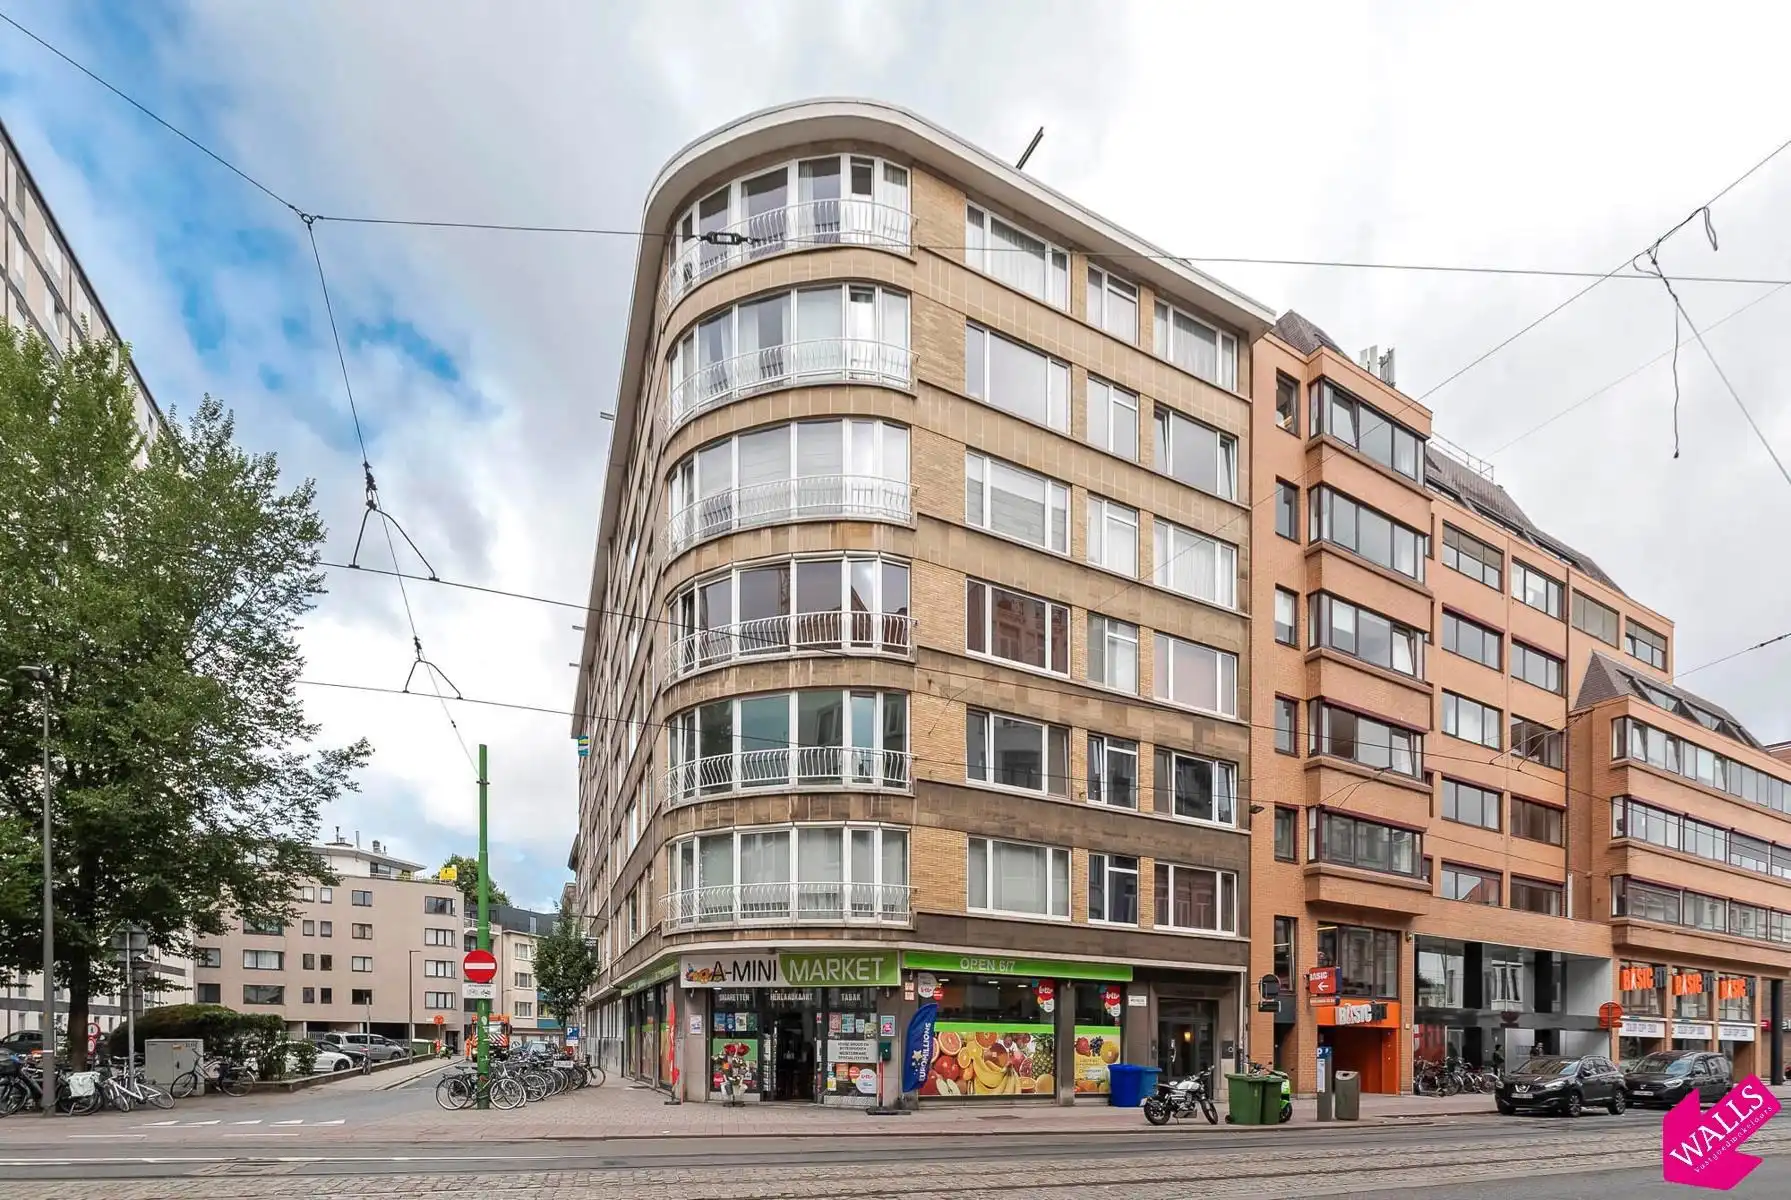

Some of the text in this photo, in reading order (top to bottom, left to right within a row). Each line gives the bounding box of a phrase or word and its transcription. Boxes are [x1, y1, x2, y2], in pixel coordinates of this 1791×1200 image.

[711, 957, 885, 982] A-MINI MARKET
[960, 957, 1016, 972] OPEN 6/7
[1620, 966, 1653, 990] BASIC
[1673, 972, 1702, 996] BASIC
[841, 993, 861, 1002] TABAK
[919, 1022, 932, 1082] EUROMILLIONS
